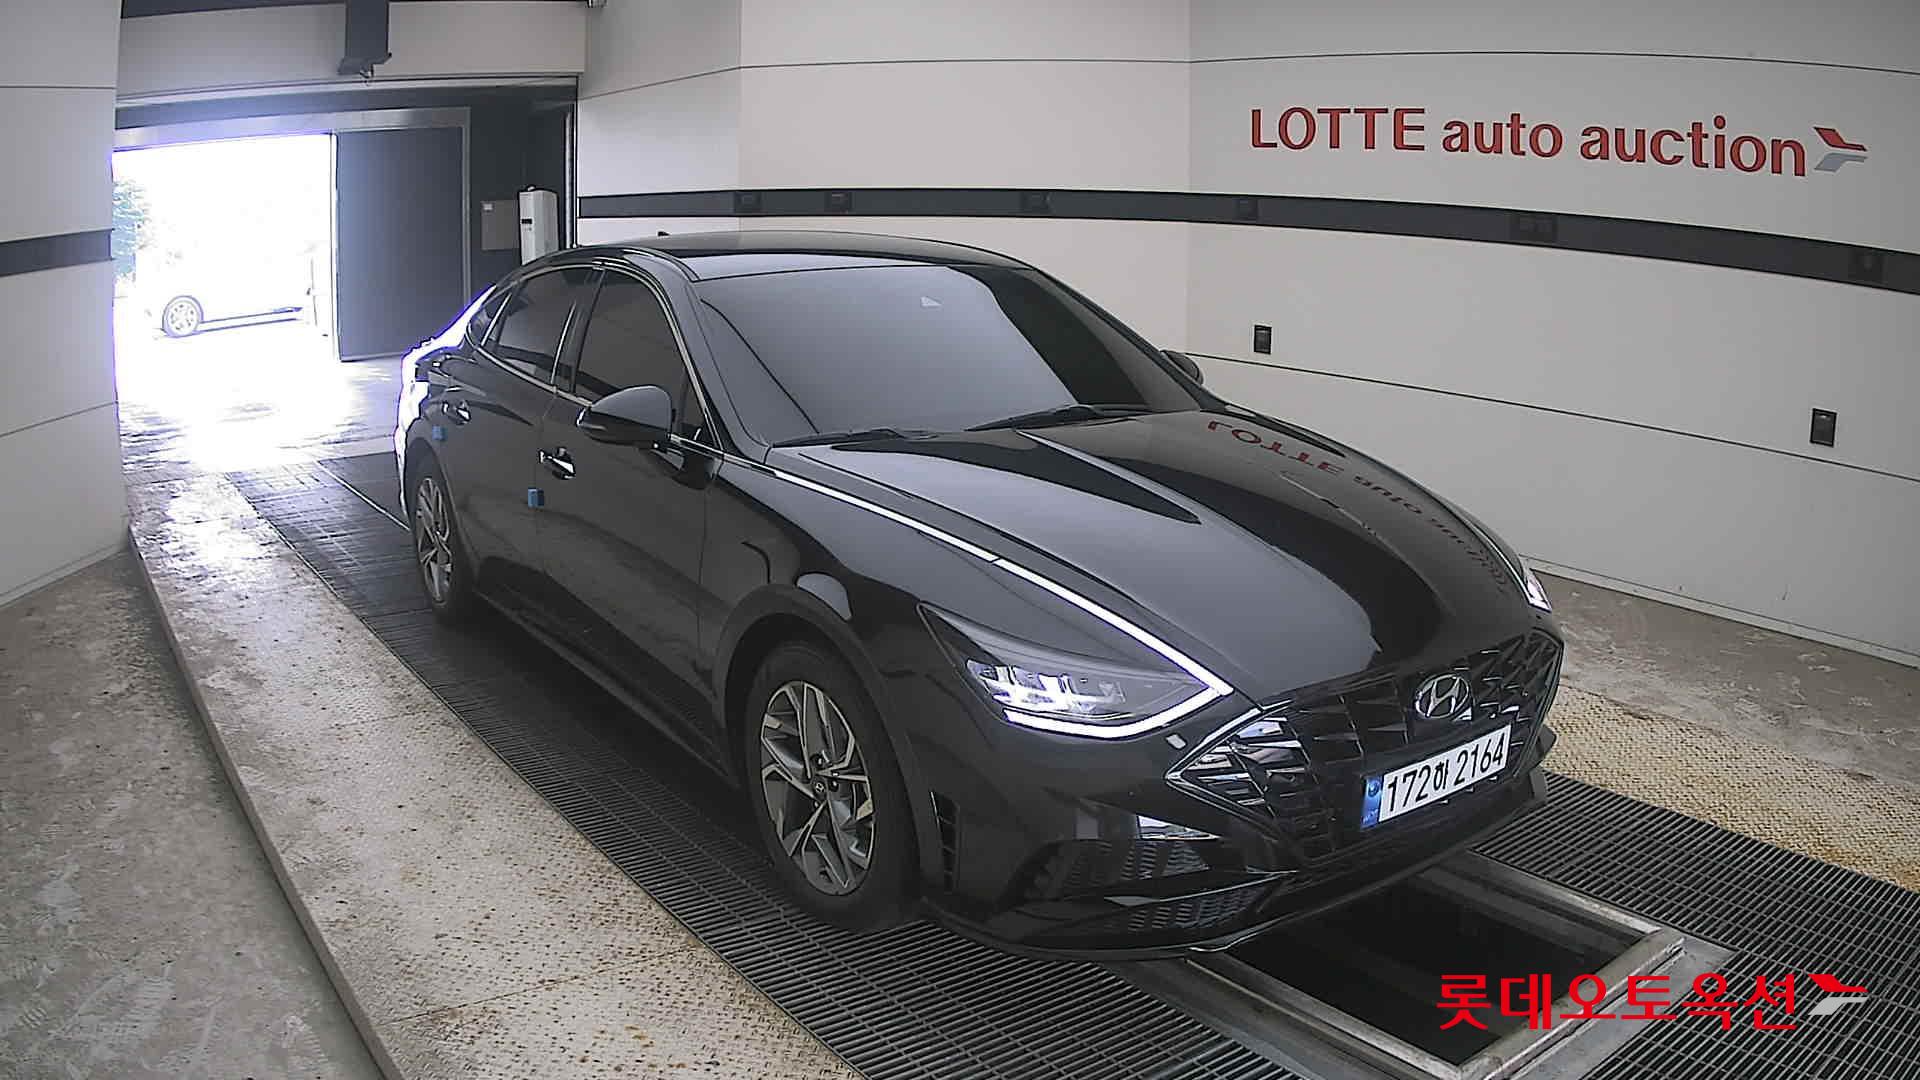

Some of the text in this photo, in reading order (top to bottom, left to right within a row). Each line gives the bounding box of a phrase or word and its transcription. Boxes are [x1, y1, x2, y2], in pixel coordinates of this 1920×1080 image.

[1251, 107, 1806, 177] LOTTE auto auction
[1387, 732, 1505, 812] 172하 2164
